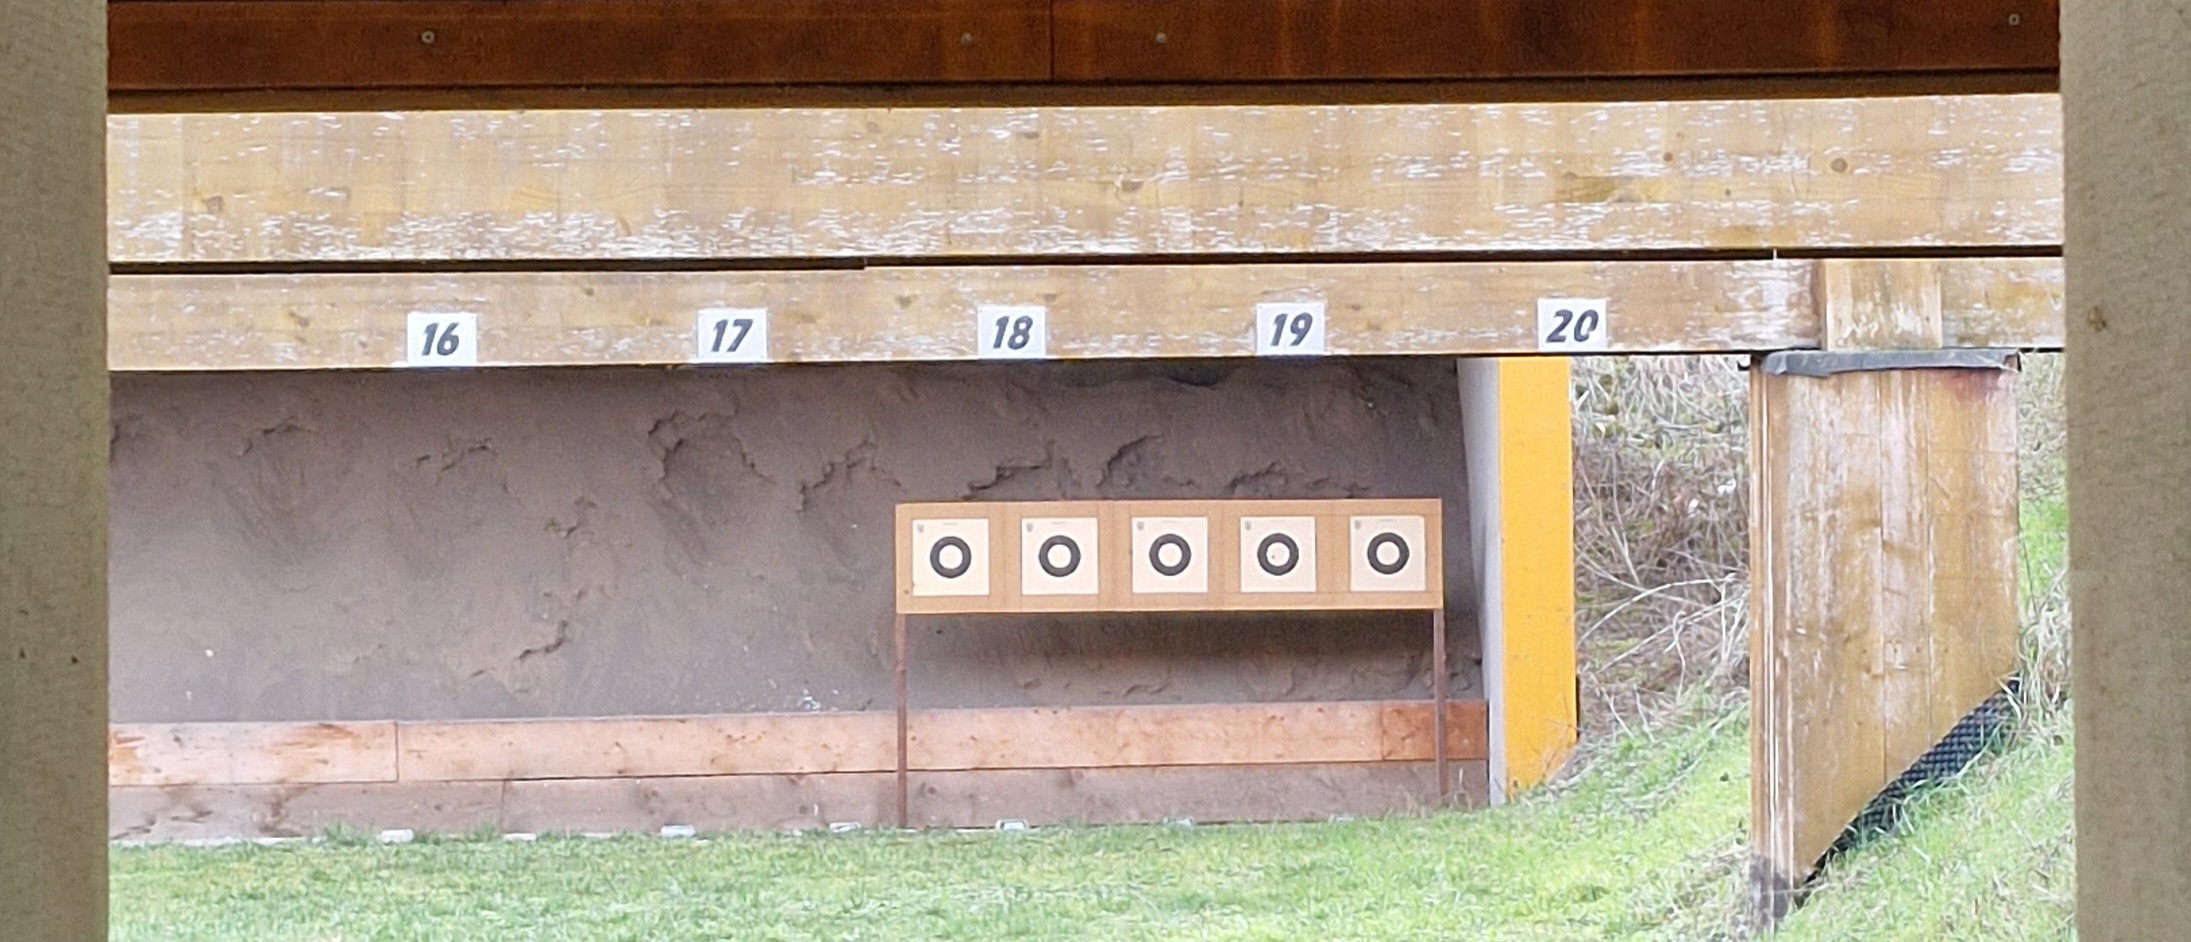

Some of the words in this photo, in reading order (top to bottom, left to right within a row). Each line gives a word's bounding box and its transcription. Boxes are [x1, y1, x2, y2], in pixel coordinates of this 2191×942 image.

[422, 323, 460, 356] 16
[711, 318, 753, 352] 17
[993, 316, 1034, 350] 18
[1271, 312, 1313, 347] 19
[1547, 309, 1599, 343] 20
